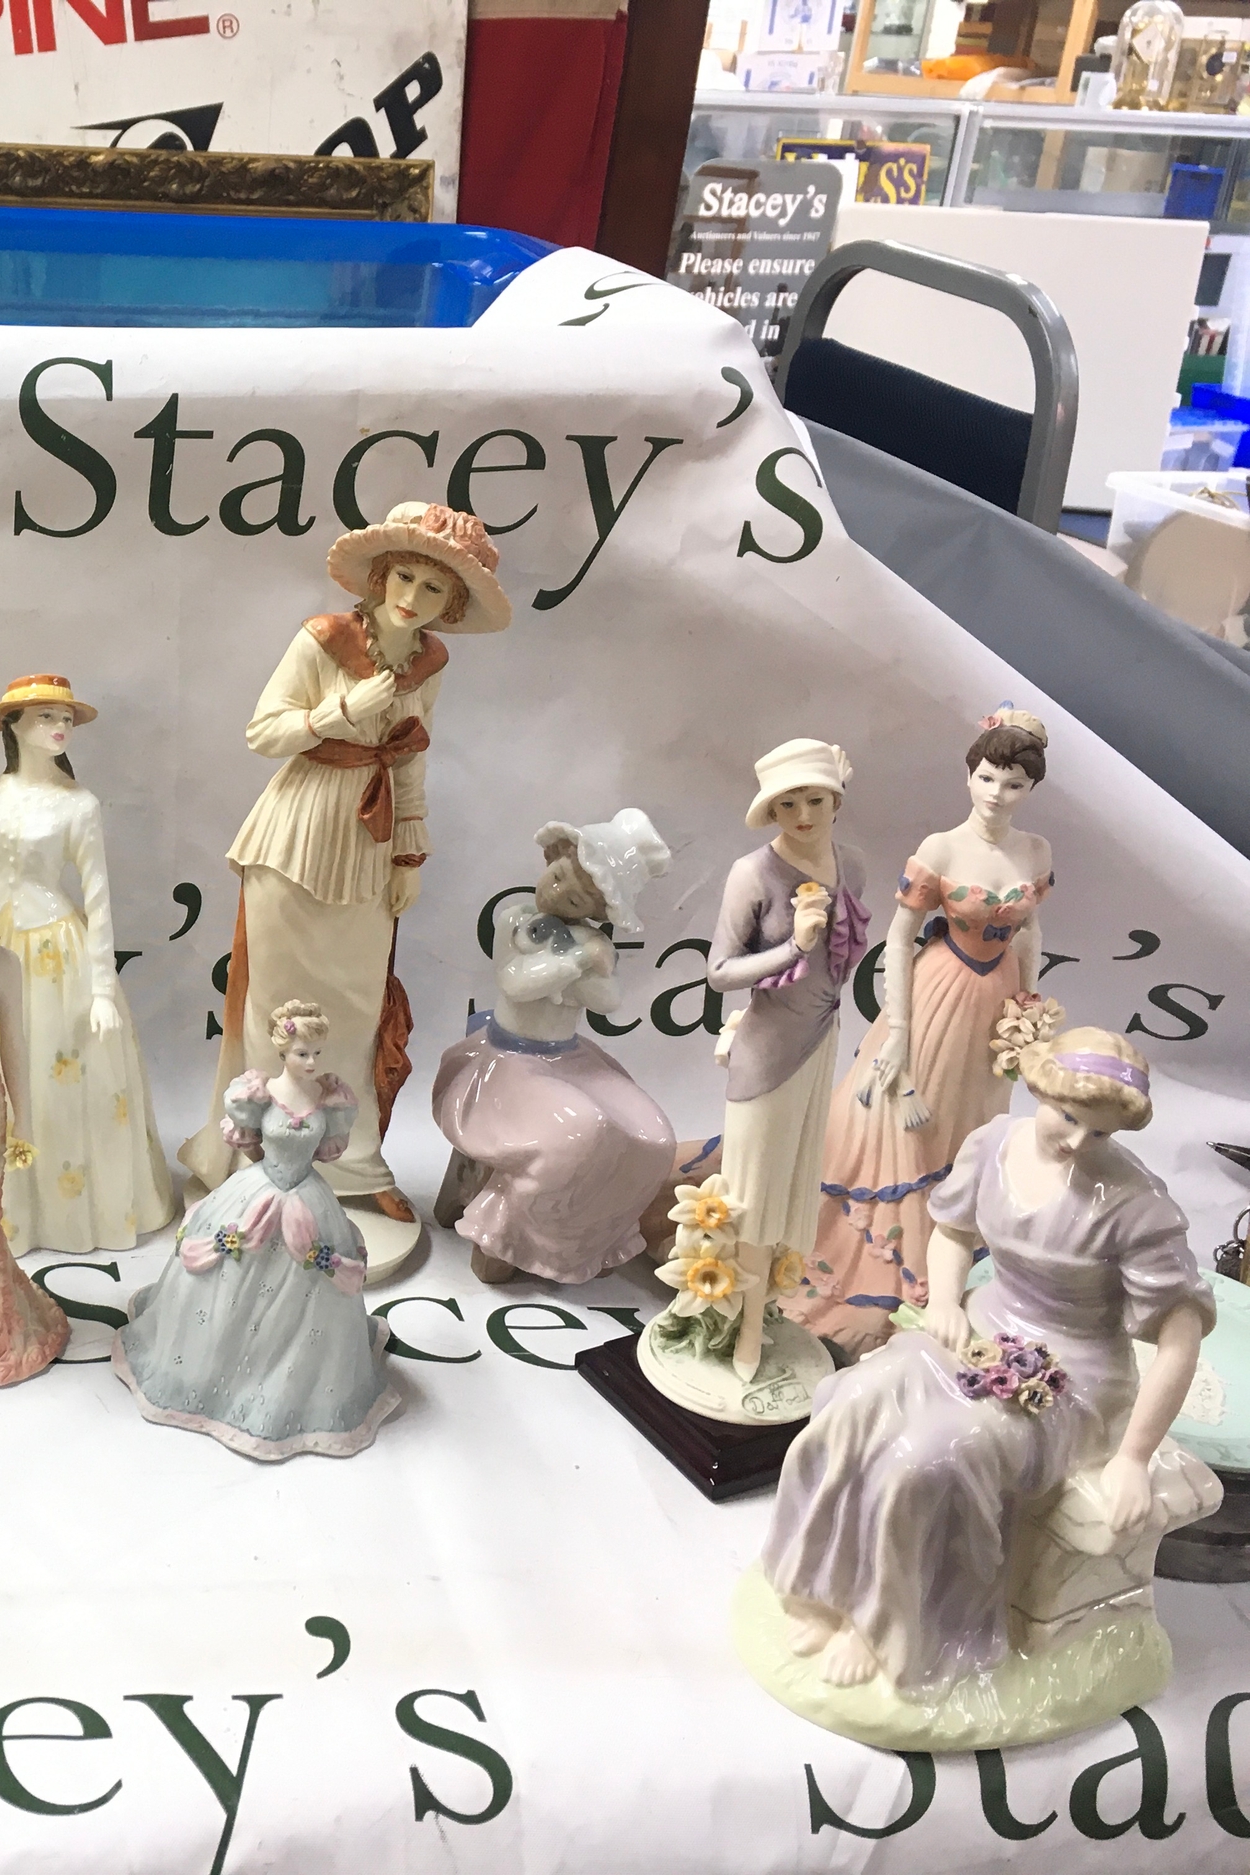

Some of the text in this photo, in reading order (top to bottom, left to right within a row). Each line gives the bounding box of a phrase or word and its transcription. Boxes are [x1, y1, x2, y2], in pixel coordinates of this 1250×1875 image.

[699, 182, 828, 226] Stacey's
[678, 252, 816, 275] Please ensure
[764, 290, 799, 308] are
[759, 320, 780, 340] in
[14, 356, 825, 611] Stacey's
